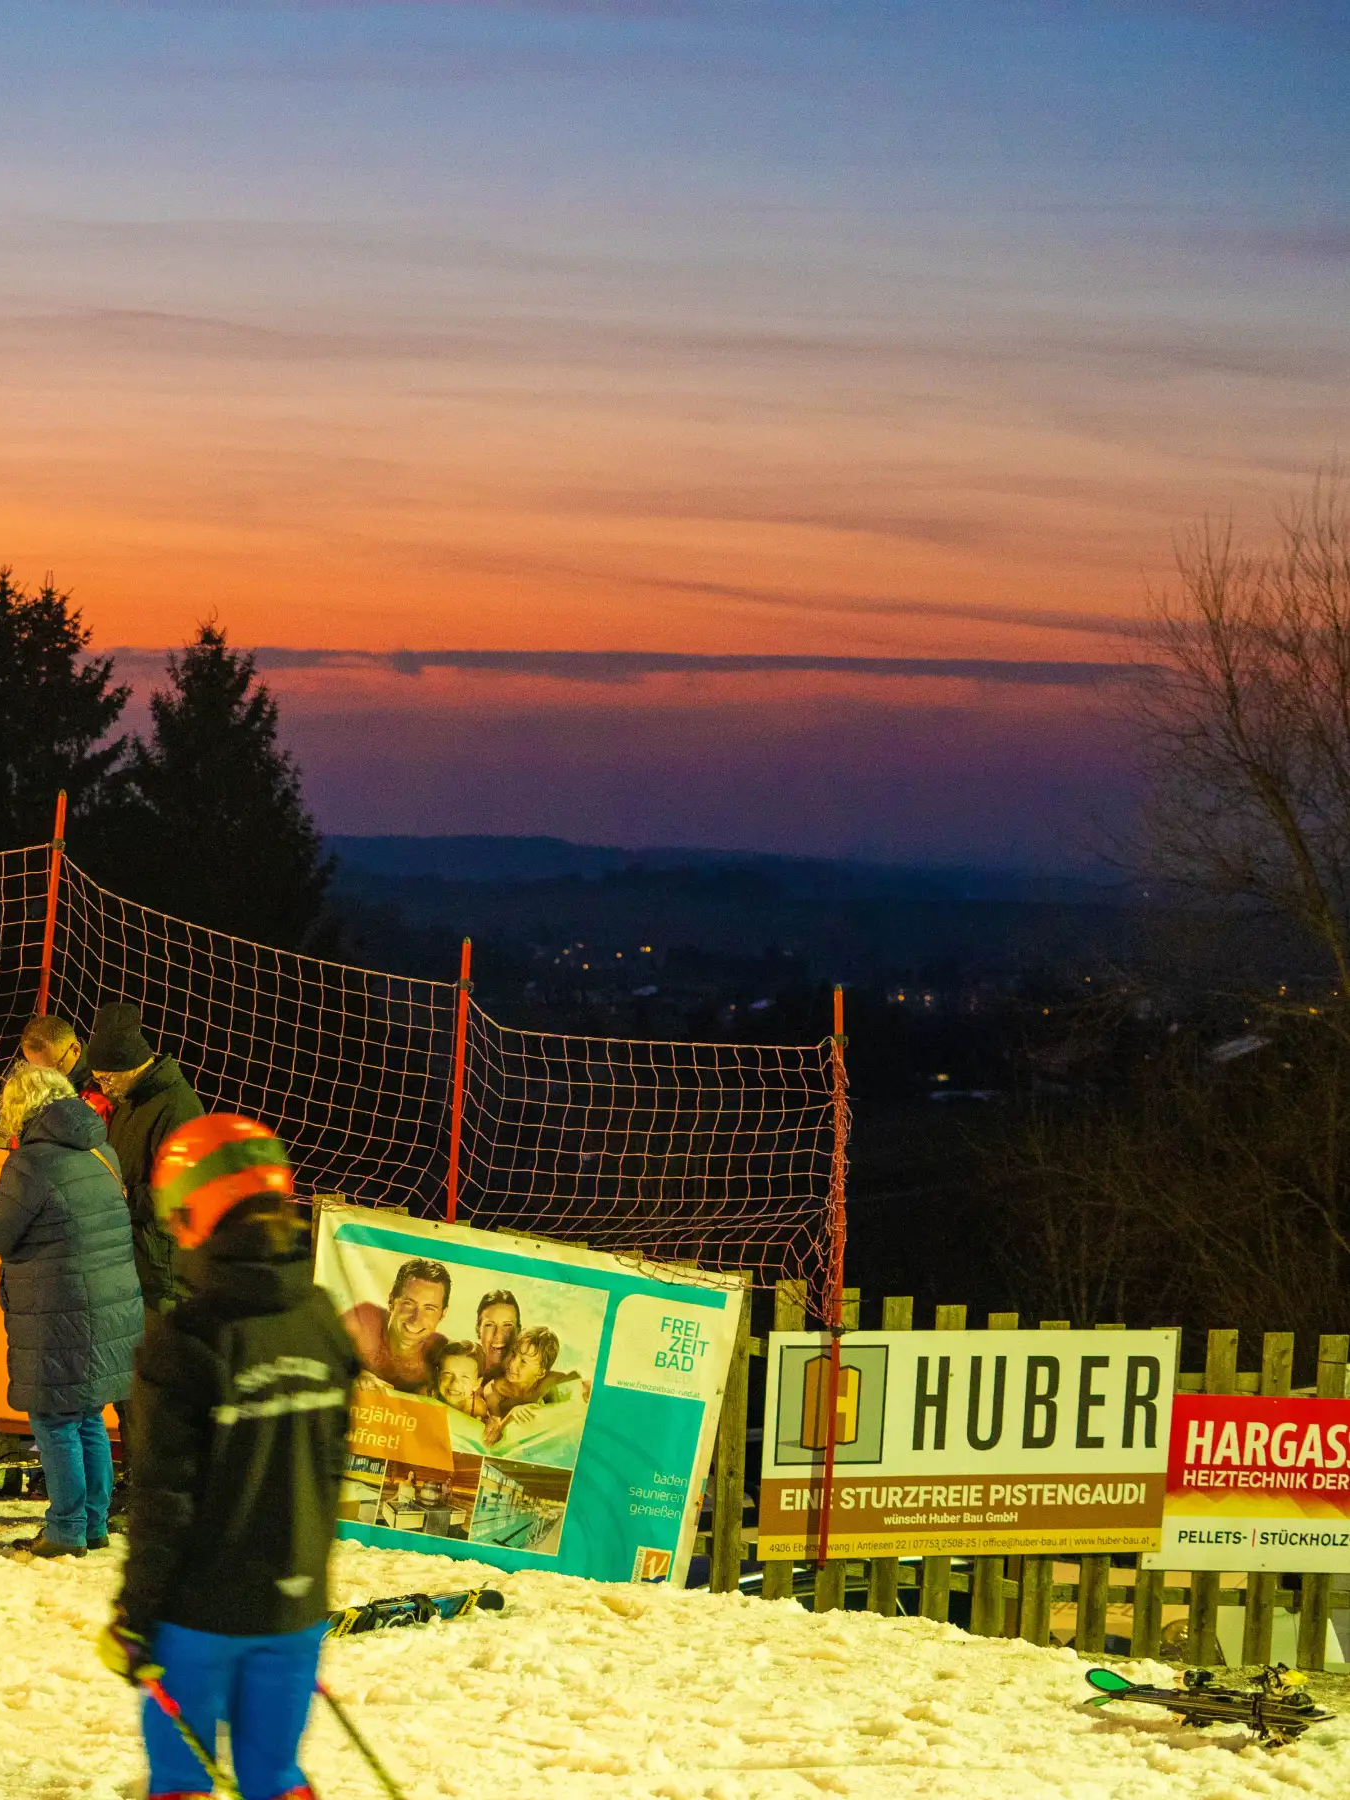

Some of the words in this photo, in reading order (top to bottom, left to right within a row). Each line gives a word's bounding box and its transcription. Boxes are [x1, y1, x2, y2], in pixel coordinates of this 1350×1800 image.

[660, 1316, 701, 1338] FREI
[668, 1335, 710, 1357] ZEIT
[654, 1351, 694, 1372] BAD
[912, 1355, 1161, 1451] HUBER
[1185, 1419, 1350, 1469] HARGAS
[653, 1471, 688, 1488] baden
[1182, 1469, 1308, 1489] HEIZTECHNIK
[1312, 1472, 1350, 1490] DER
[629, 1486, 685, 1503] saunieren
[839, 1485, 983, 1509] STURZFREIE
[989, 1482, 1147, 1506] PISTENGAUDI
[629, 1503, 682, 1520] genießen
[883, 1513, 927, 1525] wünscht
[929, 1512, 961, 1524] Huber
[963, 1512, 983, 1523] Bau
[985, 1511, 1018, 1523] GmbH
[857, 1540, 894, 1552] Antiesen
[896, 1540, 907, 1550] 22
[983, 1536, 1067, 1550] office@huber-bau.at
[1074, 1535, 1149, 1547] www.huber-bau.at
[1178, 1530, 1248, 1545] PELLETS-
[1259, 1529, 1350, 1547] STÜCKHOLZ
